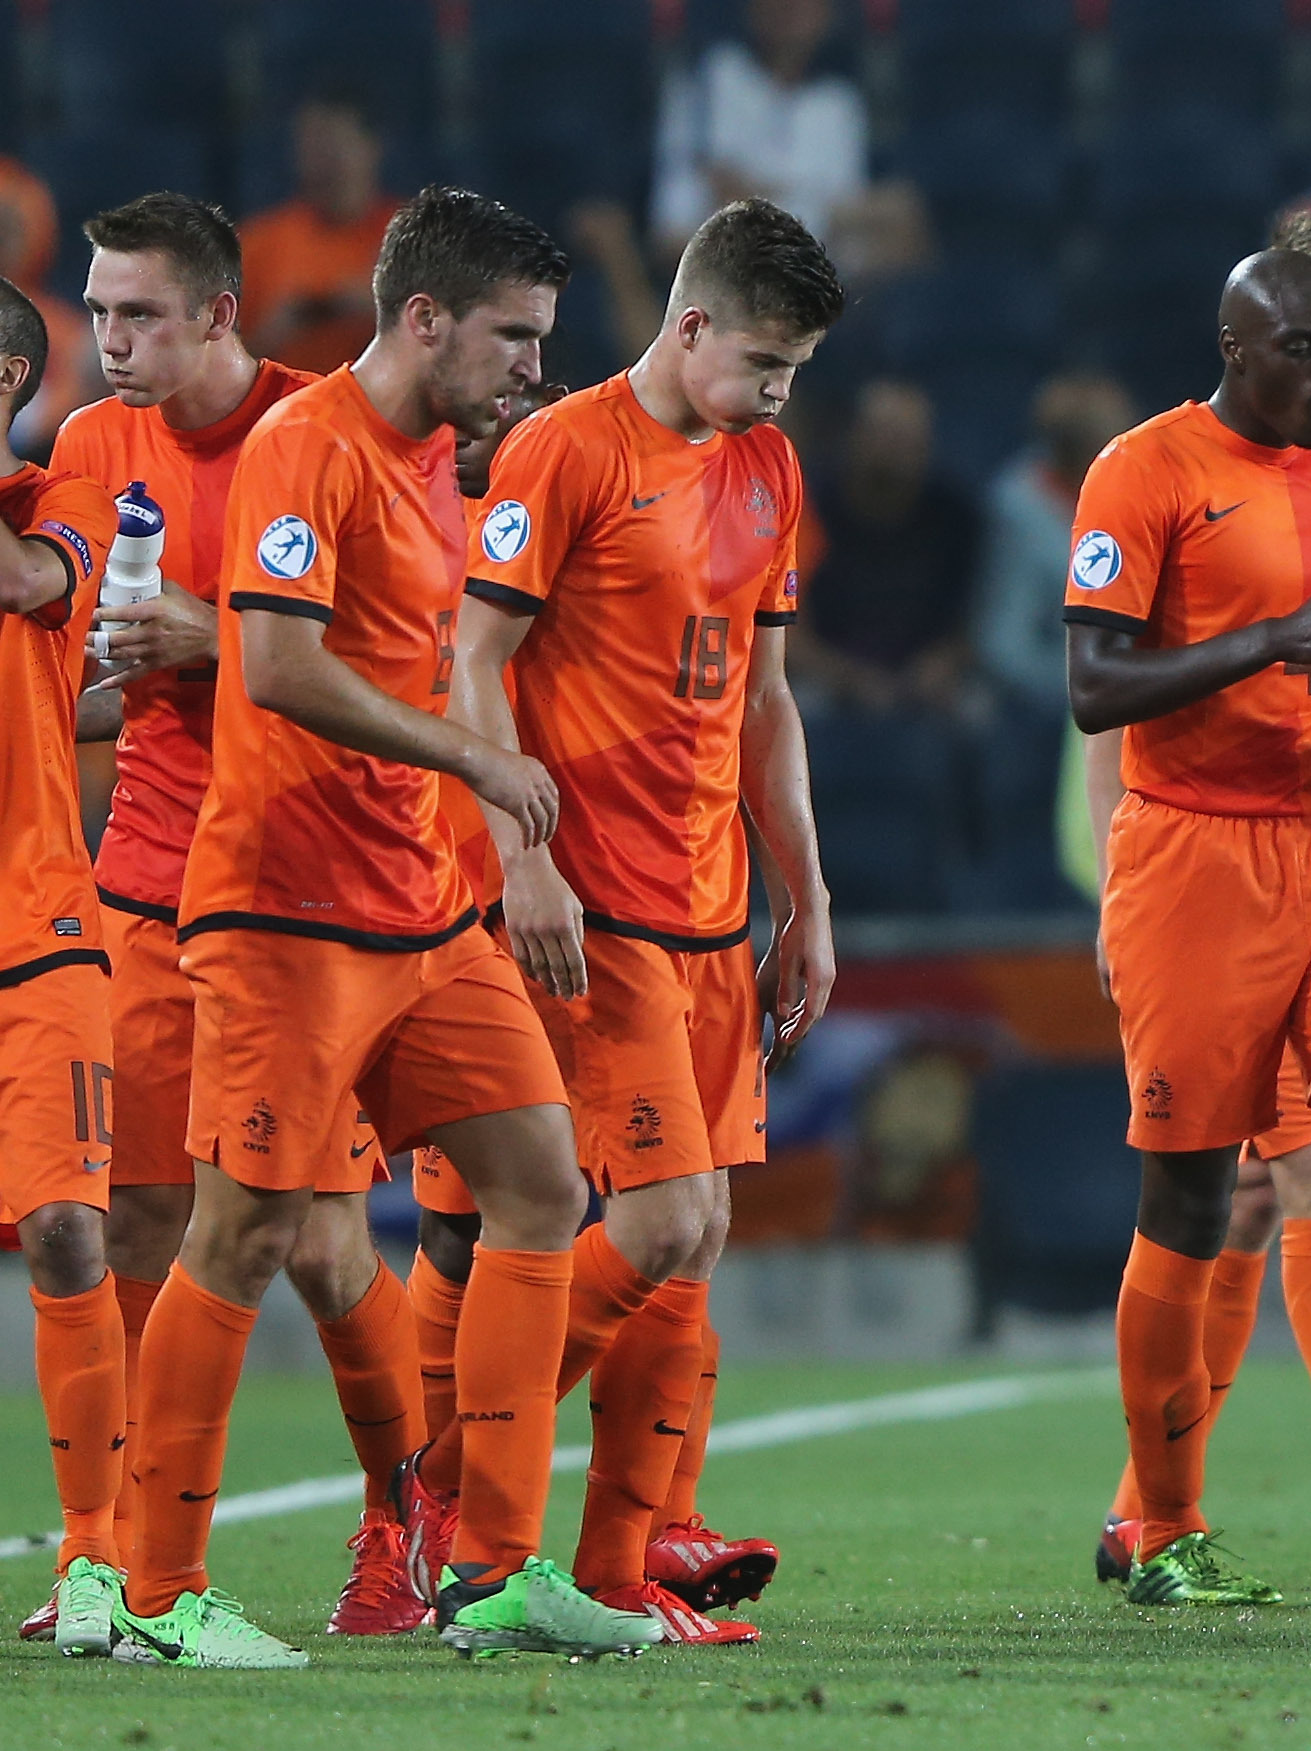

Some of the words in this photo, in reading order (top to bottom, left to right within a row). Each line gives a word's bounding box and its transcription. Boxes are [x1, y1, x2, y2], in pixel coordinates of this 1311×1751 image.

[62, 527, 92, 576] RESPECT
[674, 615, 730, 699] 18
[70, 1061, 114, 1147] 10
[243, 1142, 270, 1154] KNVB
